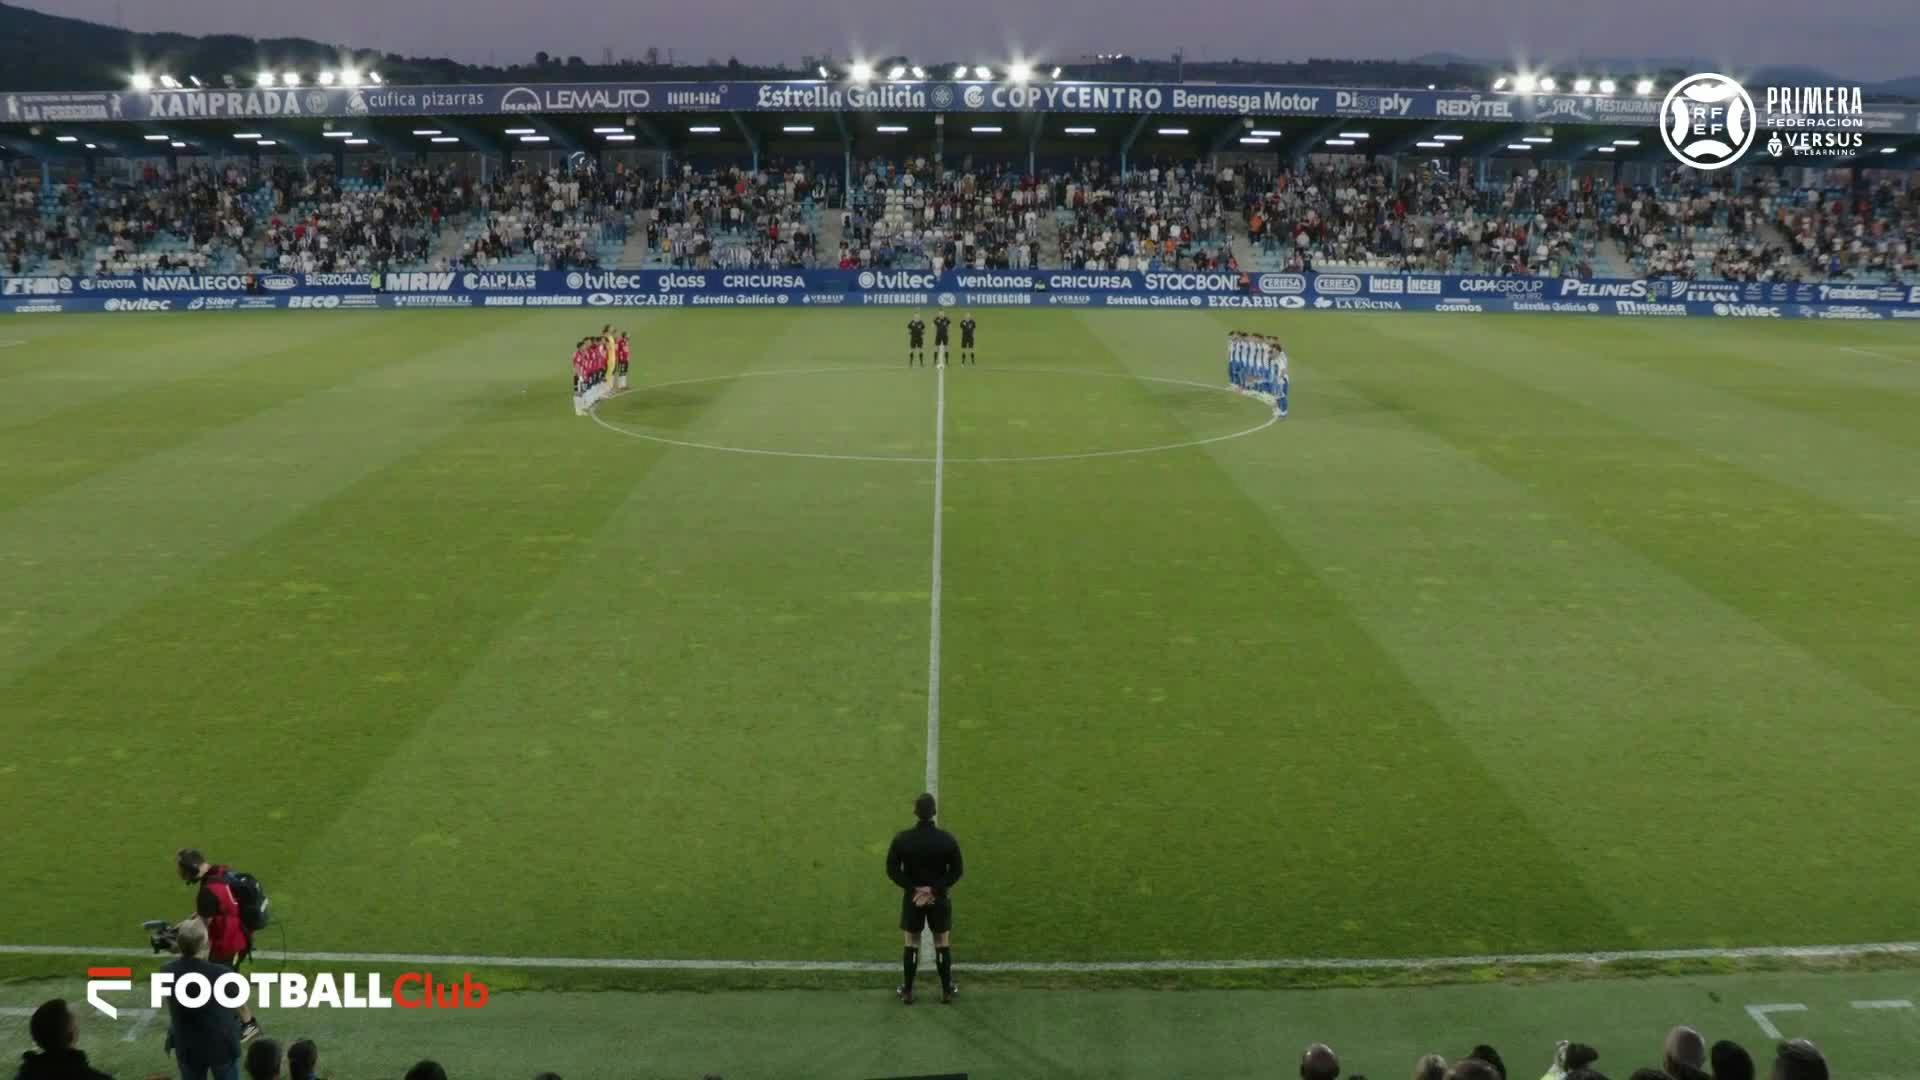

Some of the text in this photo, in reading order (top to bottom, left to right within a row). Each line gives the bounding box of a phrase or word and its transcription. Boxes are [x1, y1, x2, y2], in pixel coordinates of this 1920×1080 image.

[369, 92, 484, 109] cufica pizarras
[546, 89, 650, 109] LEMAUTO
[757, 84, 926, 108] Estrella Galicia
[991, 87, 1162, 109] COPYCENTRO
[1172, 90, 1319, 112] Bernesga Motor
[150, 92, 301, 117] XAMPRADA
[97, 279, 137, 289] TOYOTA
[143, 276, 249, 291] NAVALIEGOS
[386, 272, 457, 291] MRW
[584, 273, 706, 292] tvitec glass
[723, 275, 805, 289] CRICURSA
[877, 271, 1033, 289] tvitec ventanas
[1050, 275, 1133, 289] CRICURSA
[613, 295, 685, 306] EXCARBI
[692, 294, 775, 305] Estrella Galicia
[1106, 295, 1190, 306] Estrella Galicia
[1208, 296, 1278, 308] EXCARBI
[1434, 303, 1483, 313] cosmos
